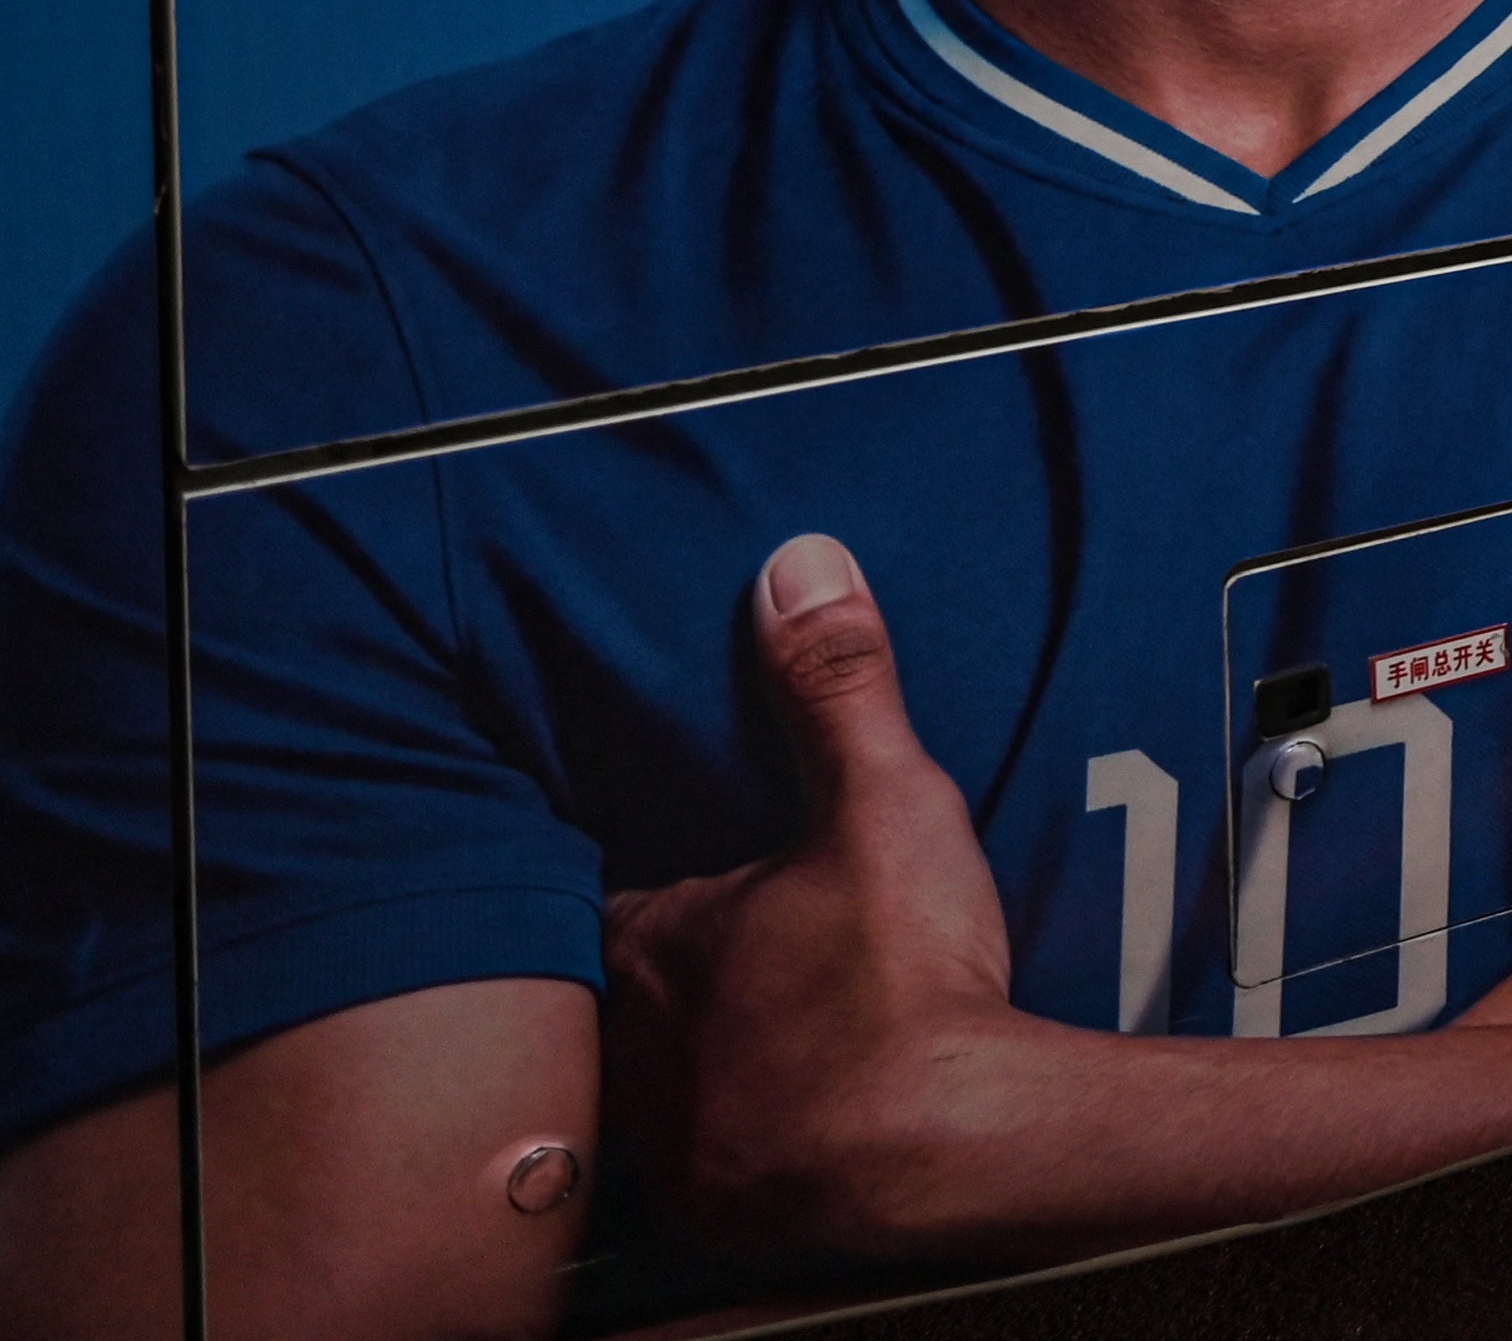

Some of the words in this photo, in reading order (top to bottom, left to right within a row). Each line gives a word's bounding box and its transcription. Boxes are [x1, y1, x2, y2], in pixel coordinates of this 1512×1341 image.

[1387, 640, 1495, 689] 手闸总开关
[1085, 693, 1454, 1039] 10
